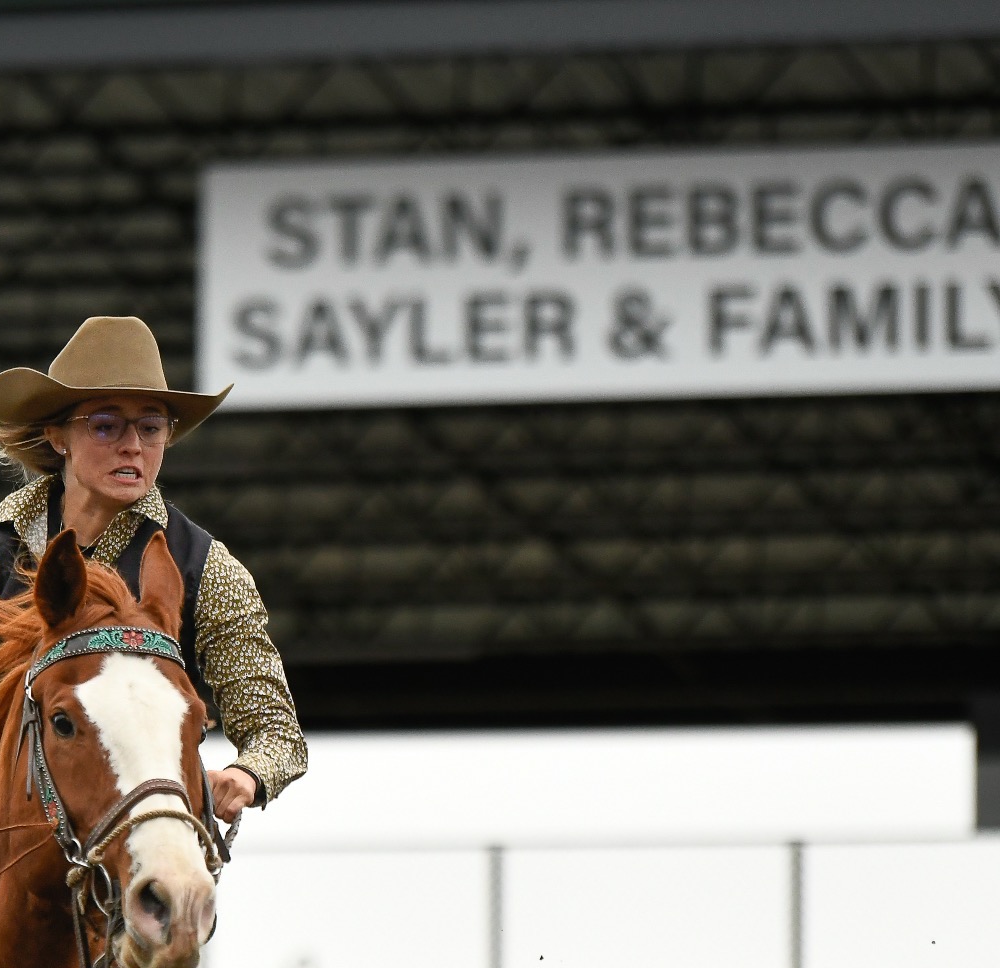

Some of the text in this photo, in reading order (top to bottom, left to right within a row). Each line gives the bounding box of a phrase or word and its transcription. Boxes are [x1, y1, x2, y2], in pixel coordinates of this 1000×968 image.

[267, 175, 1000, 273] STAN, REBECCA
[233, 280, 1000, 369] SAYLER & FAMIL
